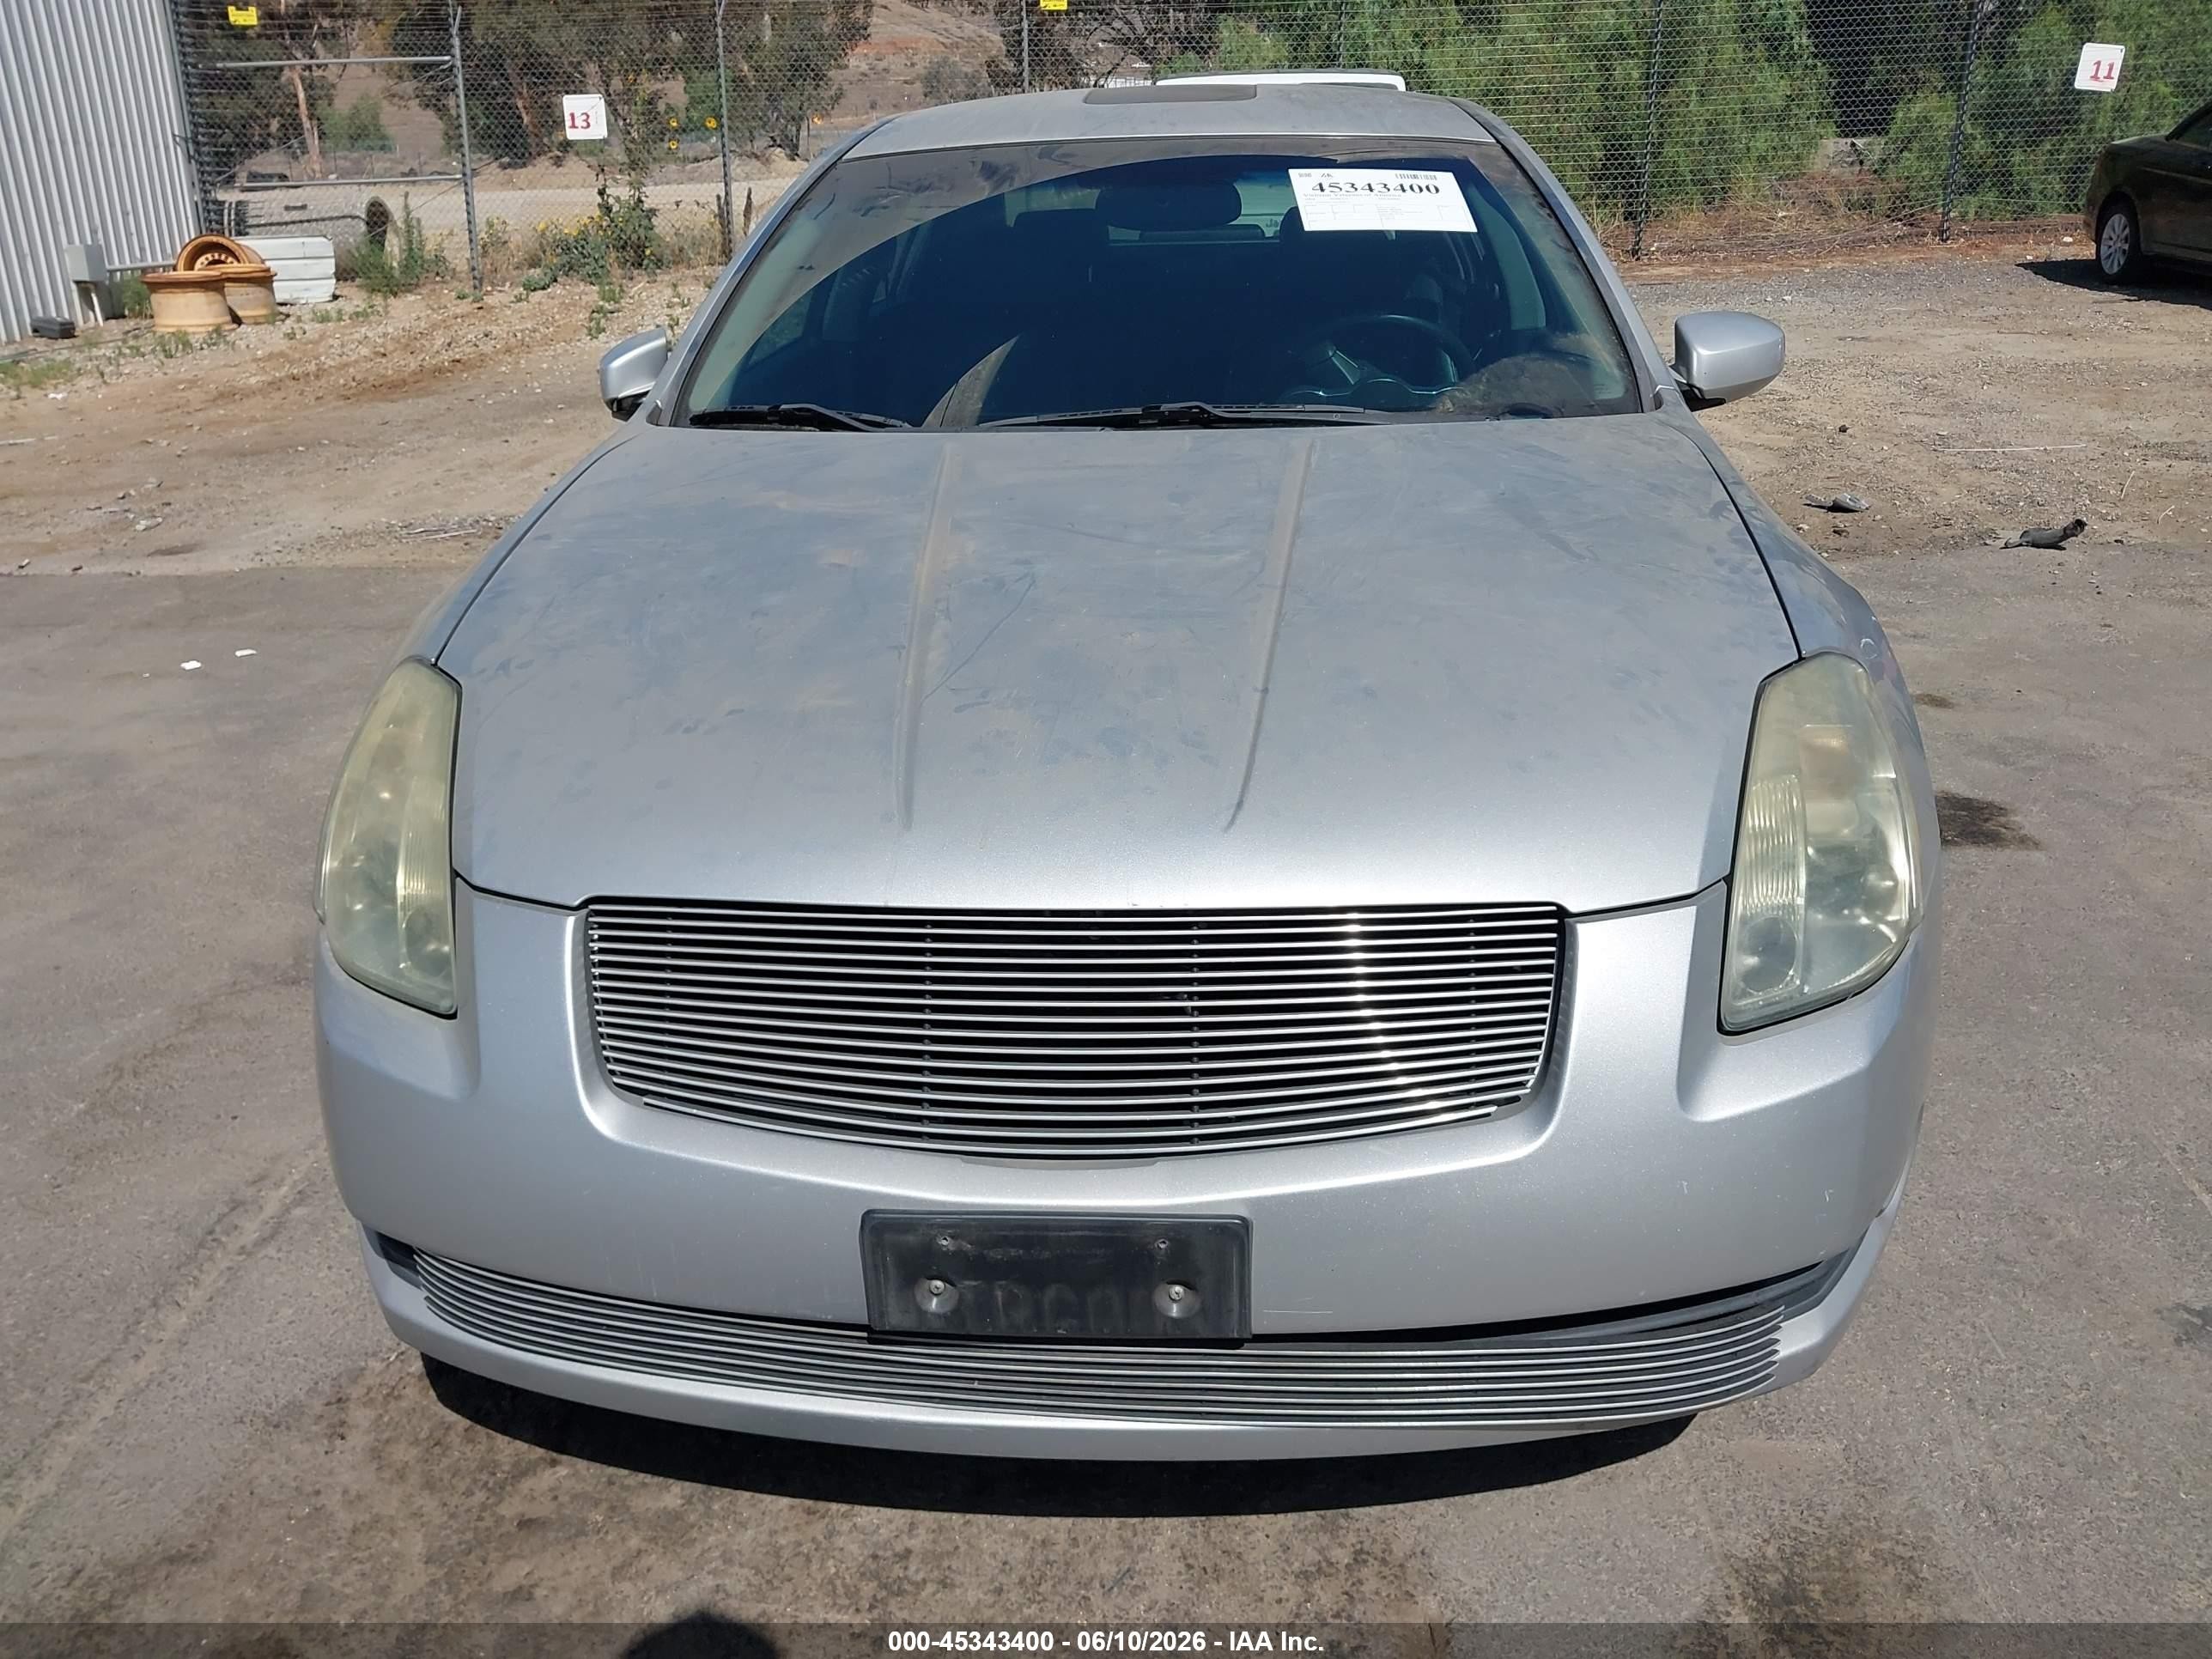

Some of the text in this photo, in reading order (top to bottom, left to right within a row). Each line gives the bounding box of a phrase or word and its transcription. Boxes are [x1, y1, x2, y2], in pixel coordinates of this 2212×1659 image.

[2089, 60, 2115, 80] 11
[568, 112, 591, 129] 13
[1312, 182, 1440, 194] 45343400
